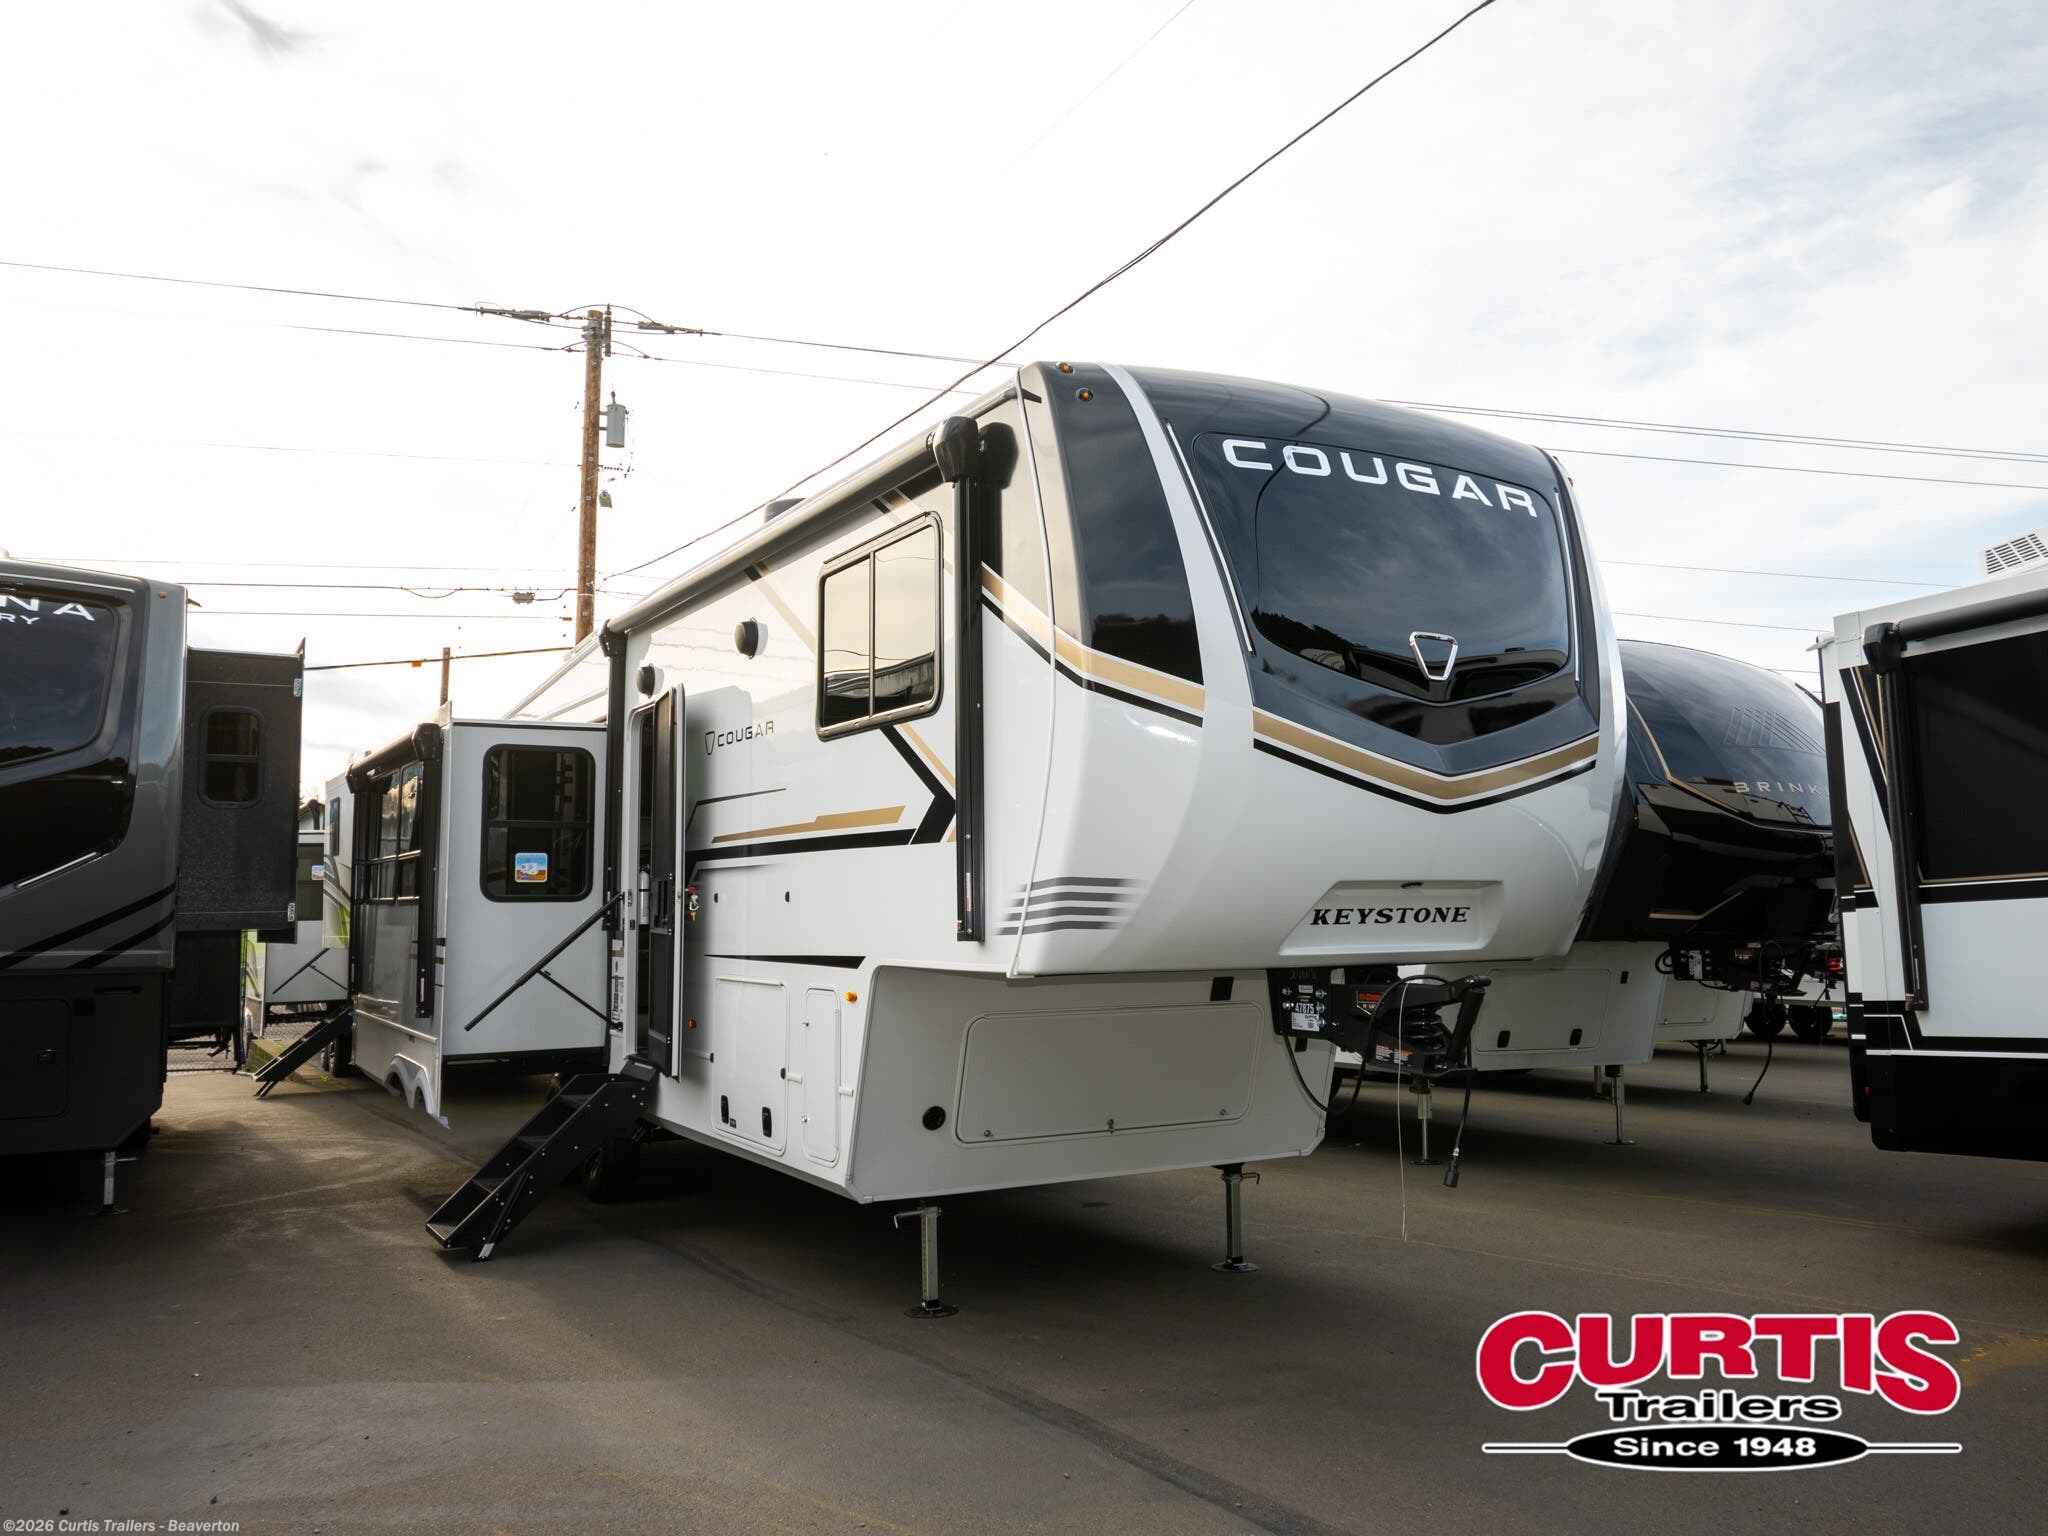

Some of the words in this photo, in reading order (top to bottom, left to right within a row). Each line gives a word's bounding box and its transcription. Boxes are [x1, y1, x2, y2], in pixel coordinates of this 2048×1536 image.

[1222, 438, 1538, 518] COUGAR
[717, 720, 775, 747] COUGAR
[1310, 907, 1470, 926] KEYSTONE
